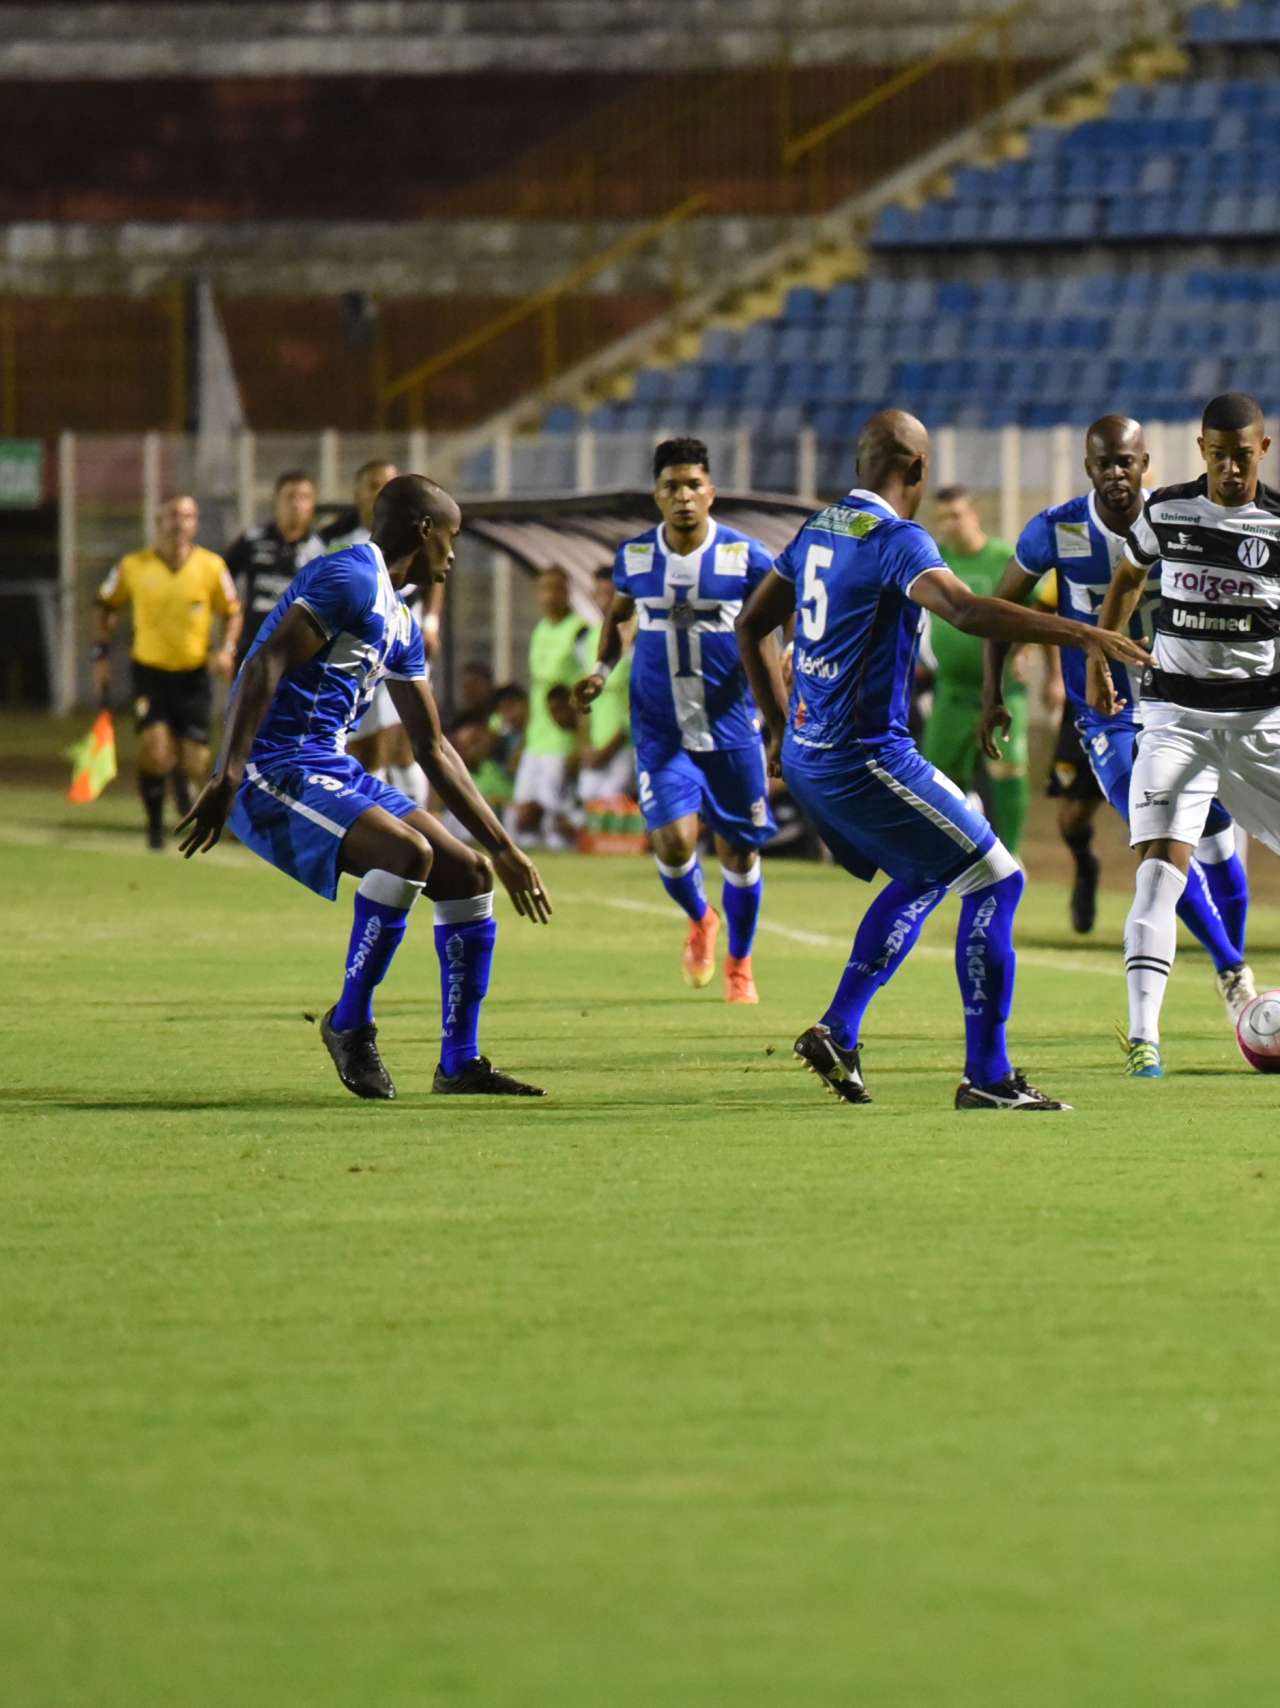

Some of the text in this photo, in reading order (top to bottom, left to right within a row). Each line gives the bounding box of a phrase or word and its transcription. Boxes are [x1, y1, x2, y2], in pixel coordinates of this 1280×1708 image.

[1160, 512, 1202, 524] Unimed
[1243, 538, 1267, 567] XV
[801, 543, 835, 642] 5
[1172, 608, 1253, 632] Unimed
[968, 895, 998, 938] AGUA
[965, 944, 989, 1001] SANTA
